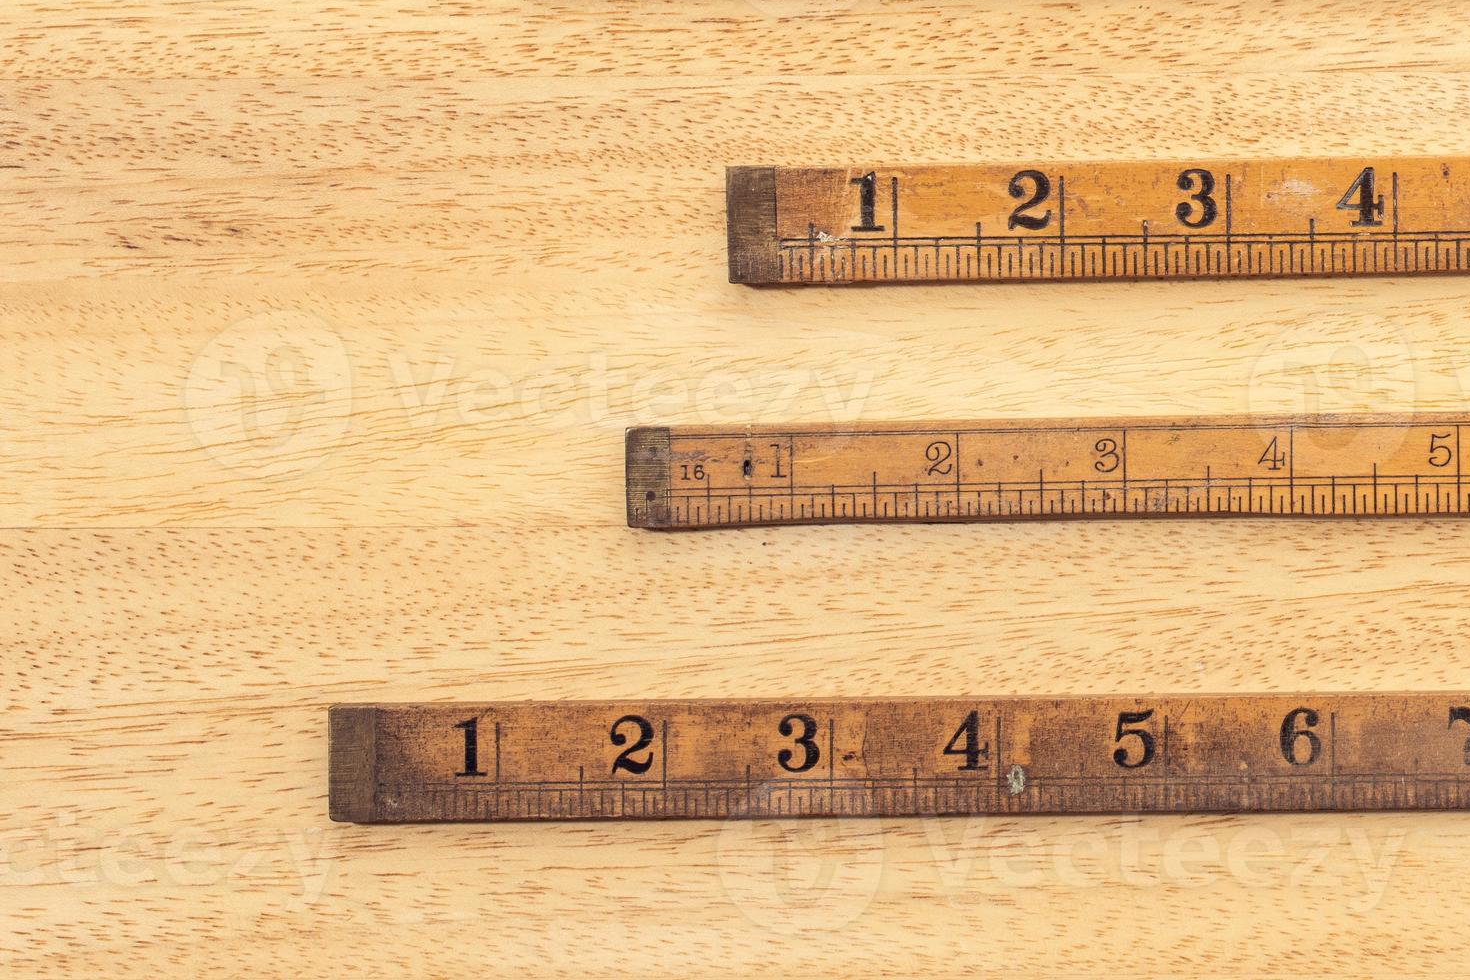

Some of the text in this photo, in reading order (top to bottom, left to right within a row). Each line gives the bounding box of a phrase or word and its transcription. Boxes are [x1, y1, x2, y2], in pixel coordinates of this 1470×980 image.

[850, 170, 885, 232] 1
[1007, 170, 1052, 230] 2
[1175, 168, 1217, 229] 3
[1335, 167, 1384, 227] 4
[680, 464, 705, 481] 16
[770, 444, 787, 478] 1
[925, 440, 953, 476] 2
[1094, 438, 1120, 473] 3
[1257, 436, 1286, 471] 4
[1428, 433, 1453, 467] 5
[454, 719, 487, 778] 1
[610, 715, 655, 775] 2
[778, 714, 818, 773] 3
[942, 710, 990, 771] 4
[1113, 708, 1156, 770] 5
[1279, 706, 1323, 768] 6
